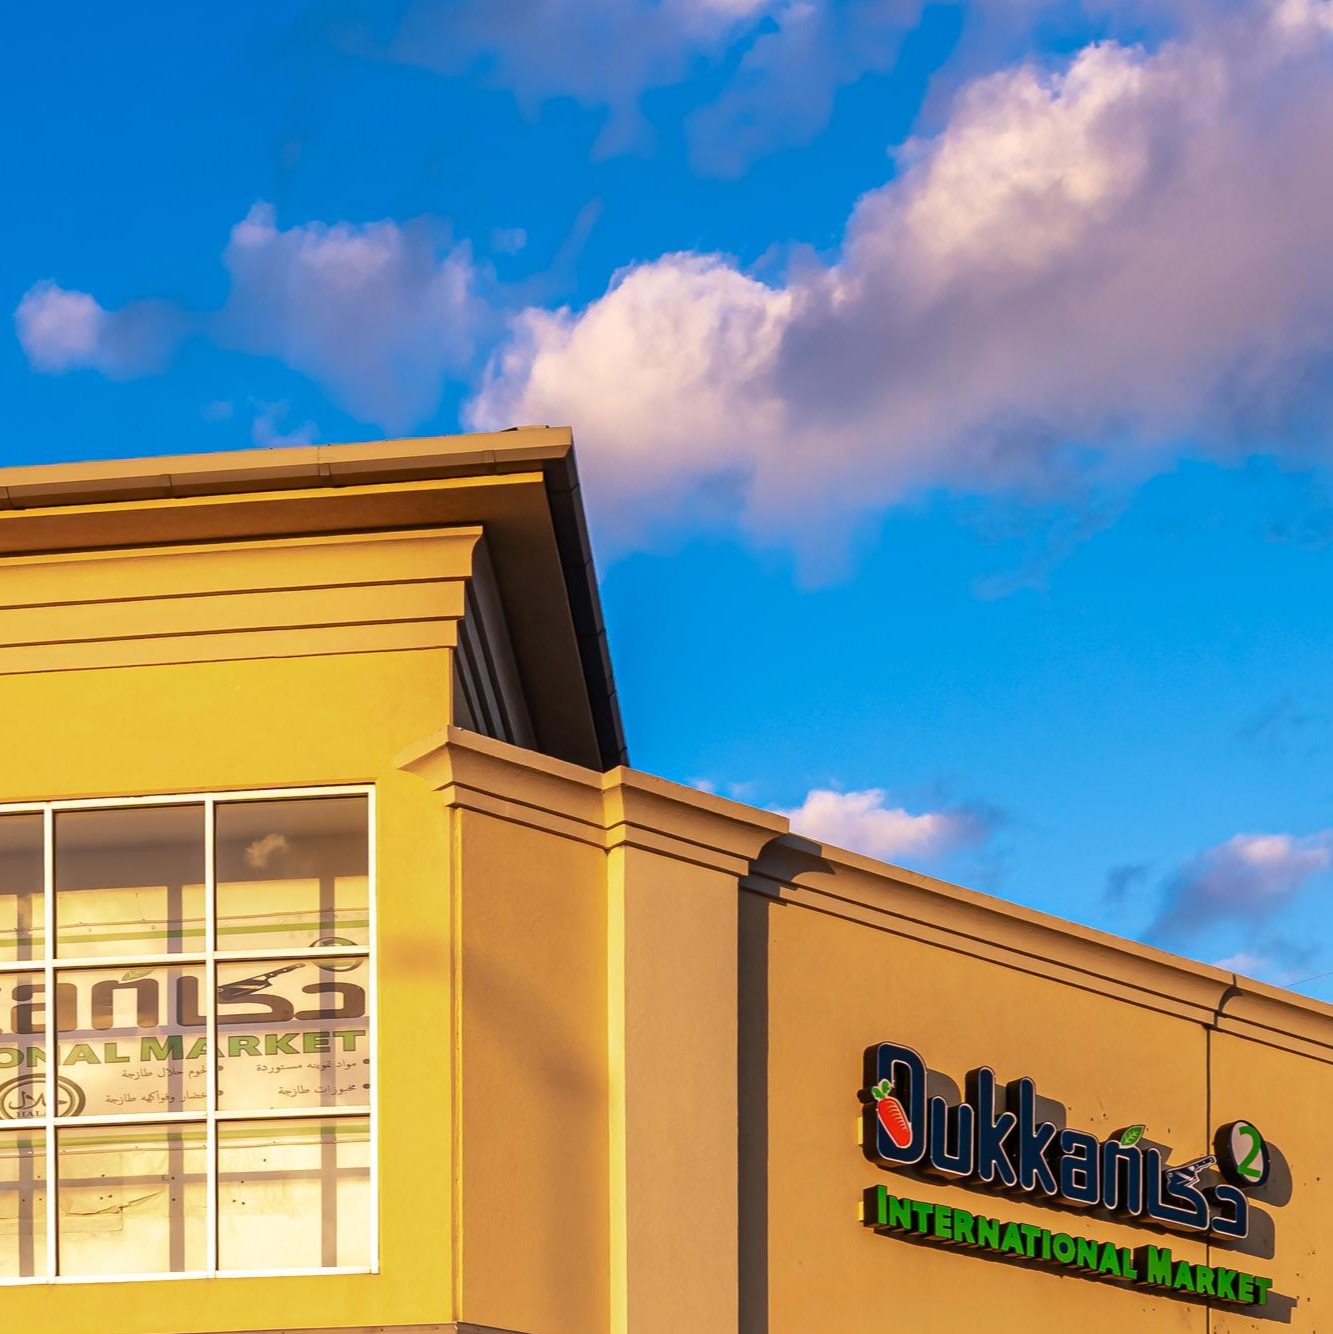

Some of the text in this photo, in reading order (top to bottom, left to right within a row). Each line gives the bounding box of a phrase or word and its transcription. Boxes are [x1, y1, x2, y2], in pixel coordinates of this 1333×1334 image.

[140, 1029, 367, 1061] MARKET
[1236, 1125, 1263, 1178] 2
[876, 1185, 1273, 1306] INTERNATIONAL MARKET
